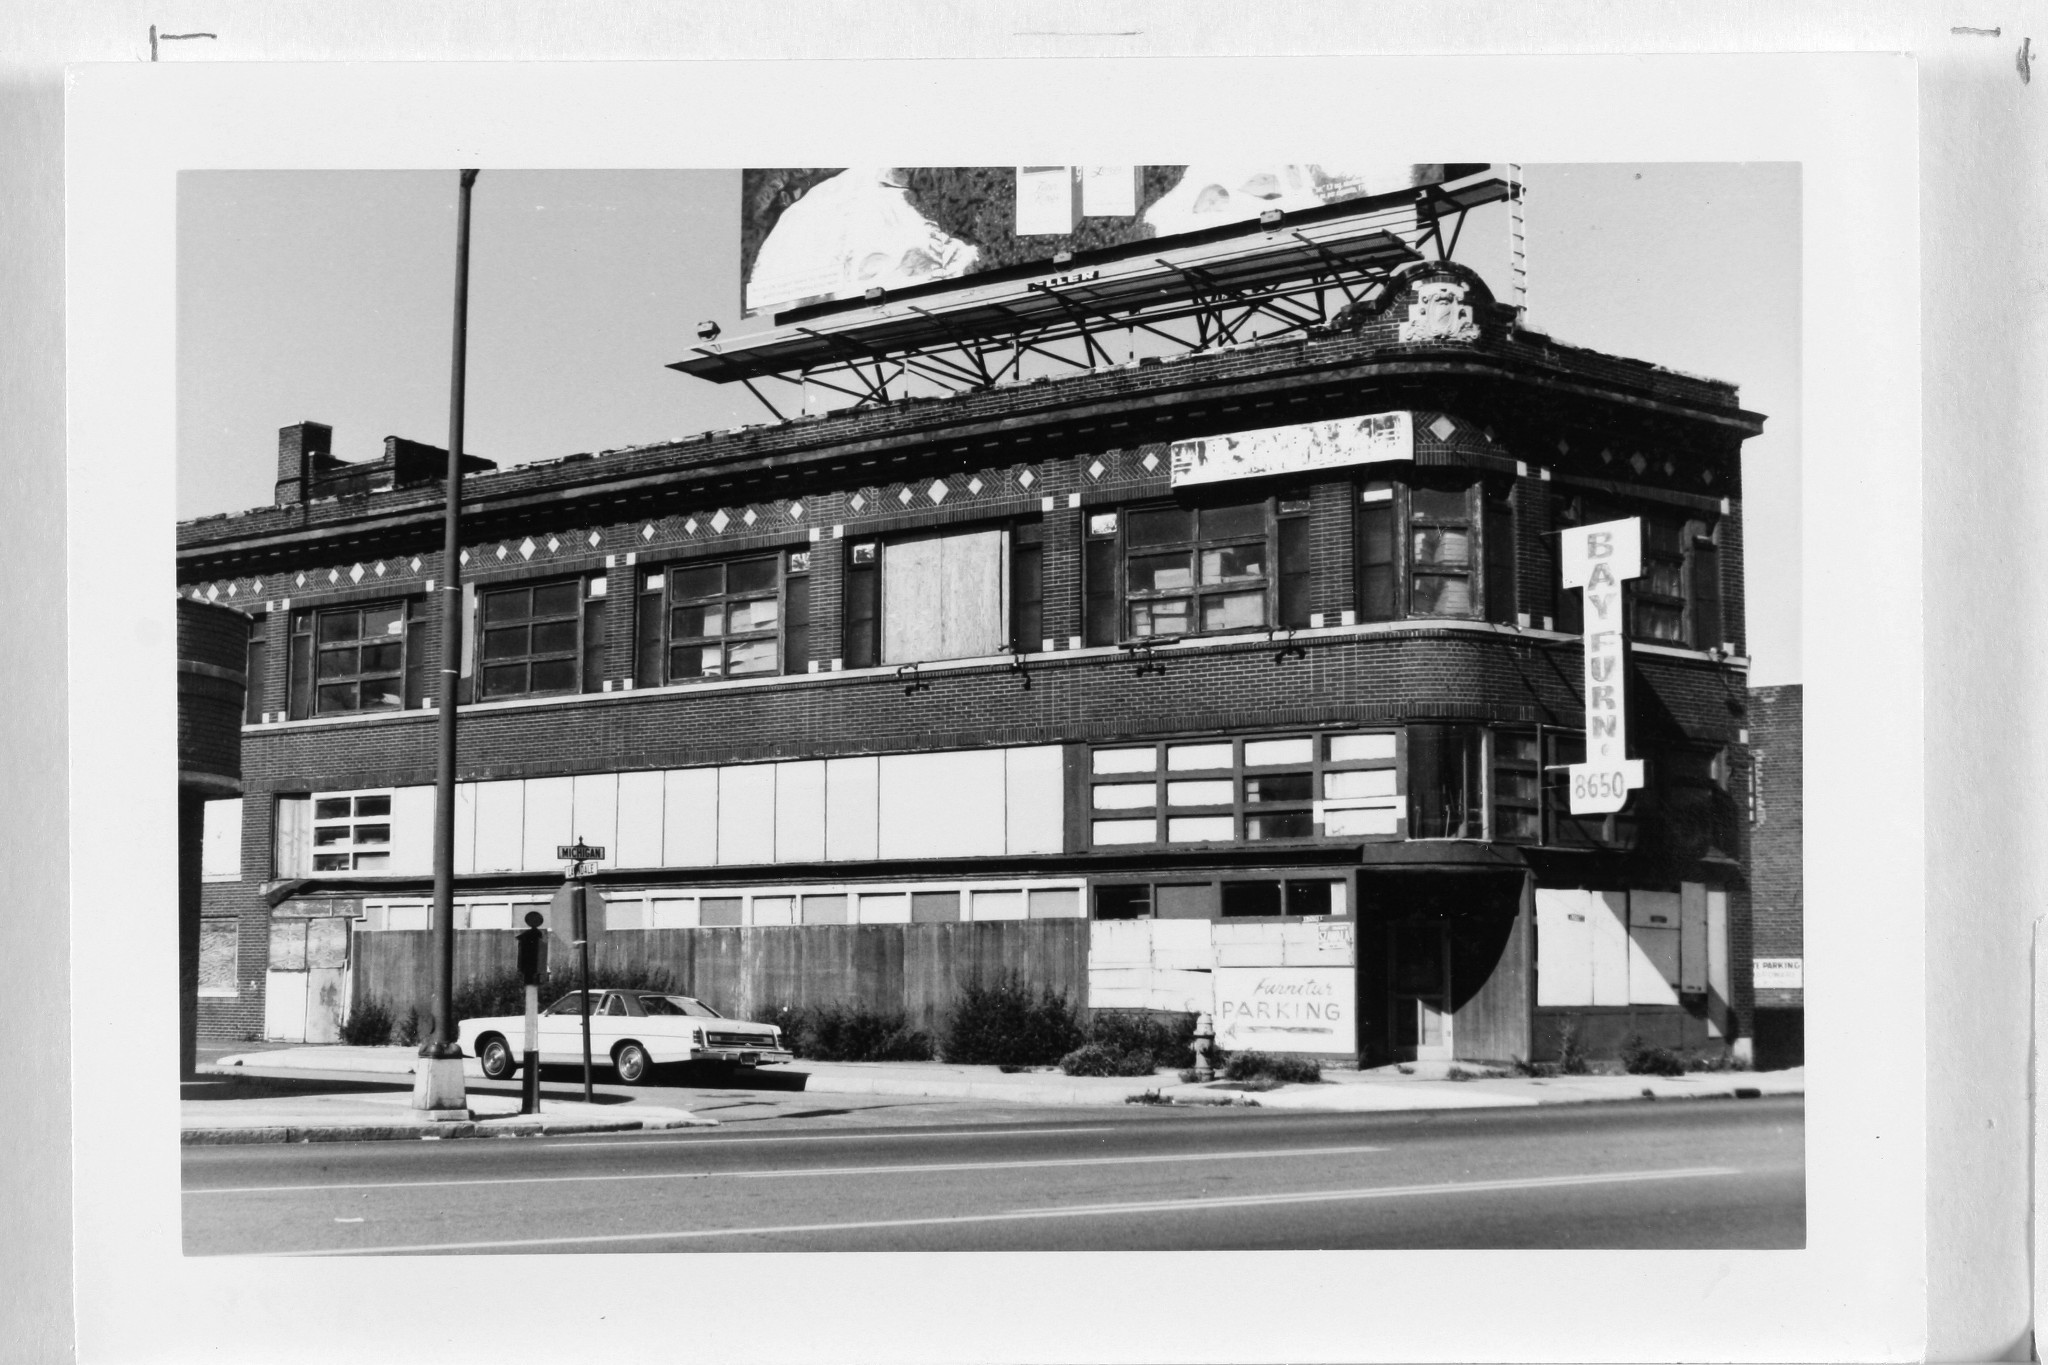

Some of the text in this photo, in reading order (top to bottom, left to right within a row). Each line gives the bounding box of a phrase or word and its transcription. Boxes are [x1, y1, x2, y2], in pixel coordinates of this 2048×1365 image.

[1587, 532, 1616, 620] BAY
[1575, 771, 1625, 799] 8650
[562, 848, 601, 858] MICHIGAN
[1762, 961, 1801, 969] PARKING
[1222, 1001, 1341, 1021] PARKING
